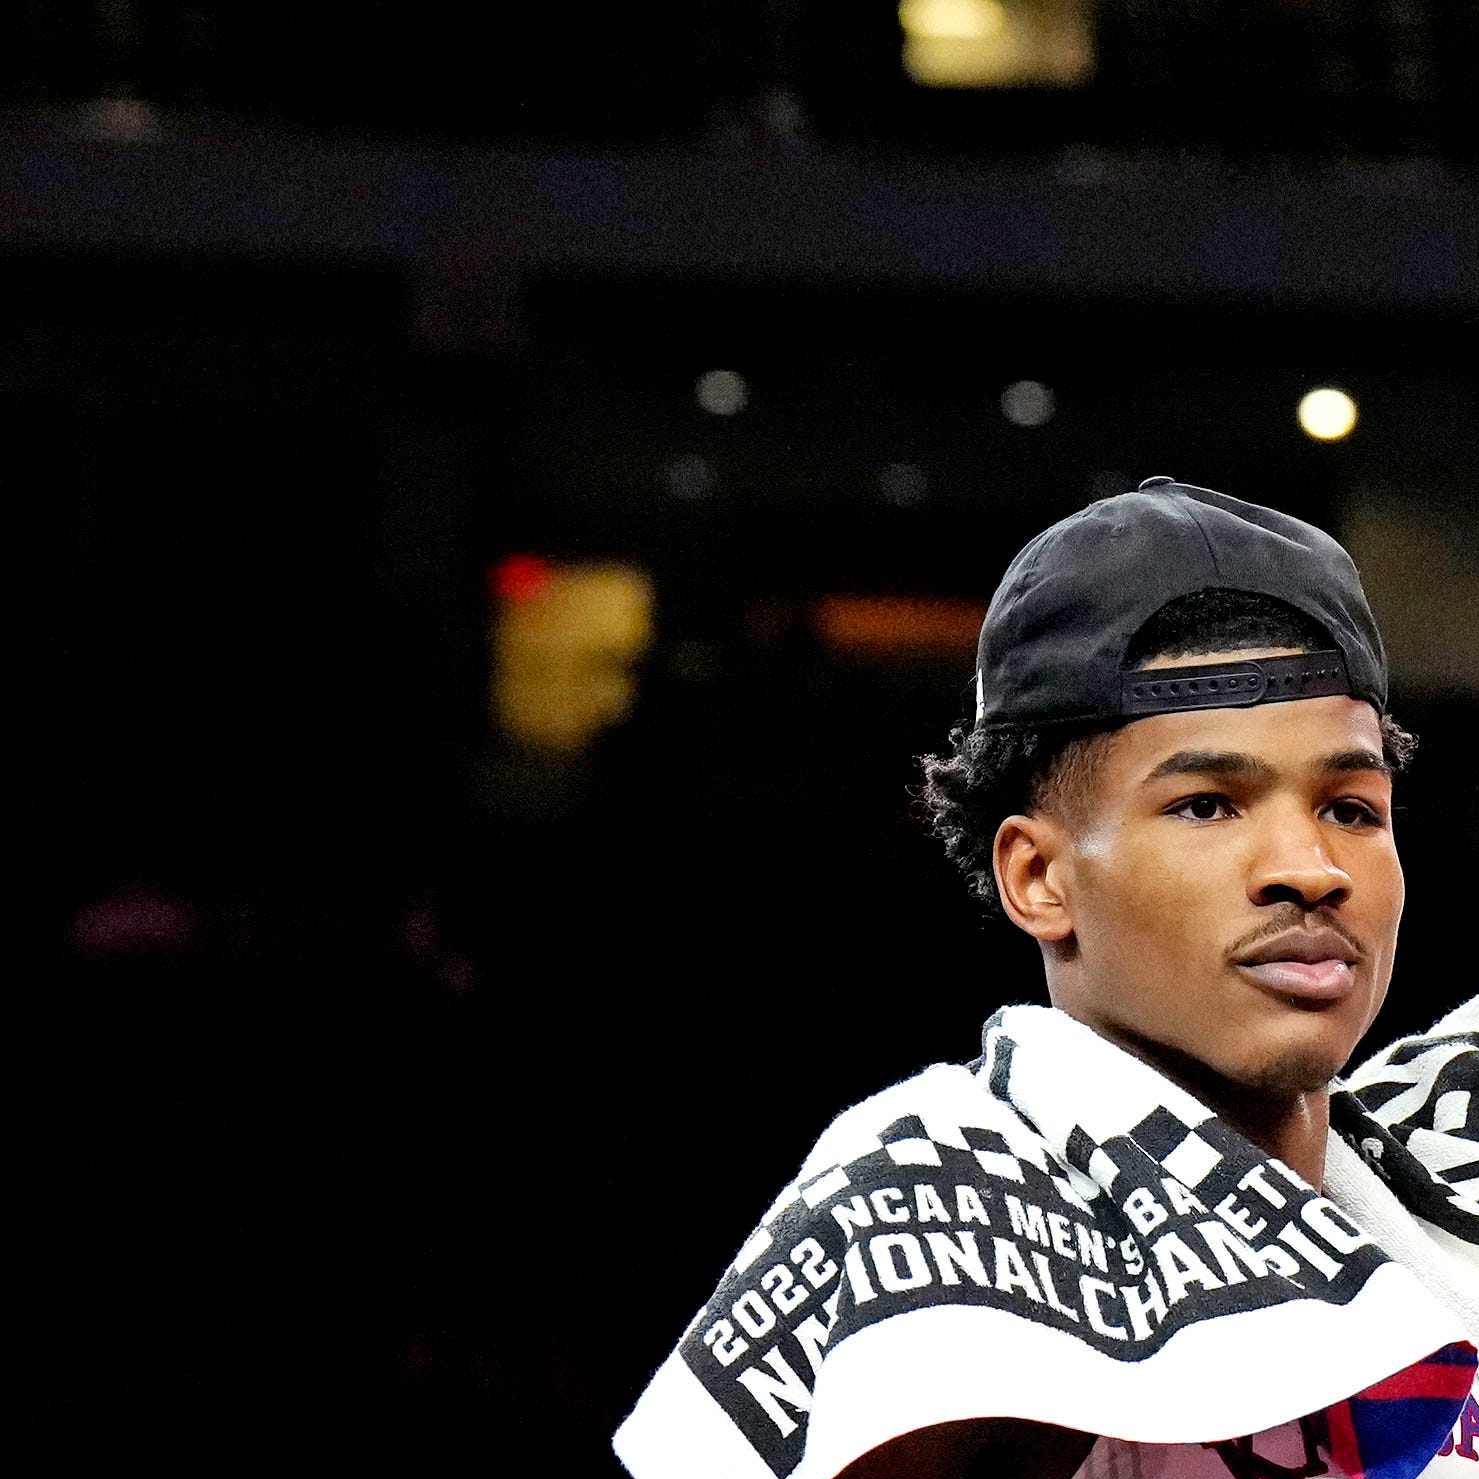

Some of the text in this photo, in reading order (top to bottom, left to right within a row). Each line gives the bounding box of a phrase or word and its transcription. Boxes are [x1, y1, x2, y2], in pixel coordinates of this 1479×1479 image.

[704, 1237, 839, 1367] 2022
[831, 1183, 992, 1243] NCAA
[1004, 1192, 1145, 1276] MEN'S
